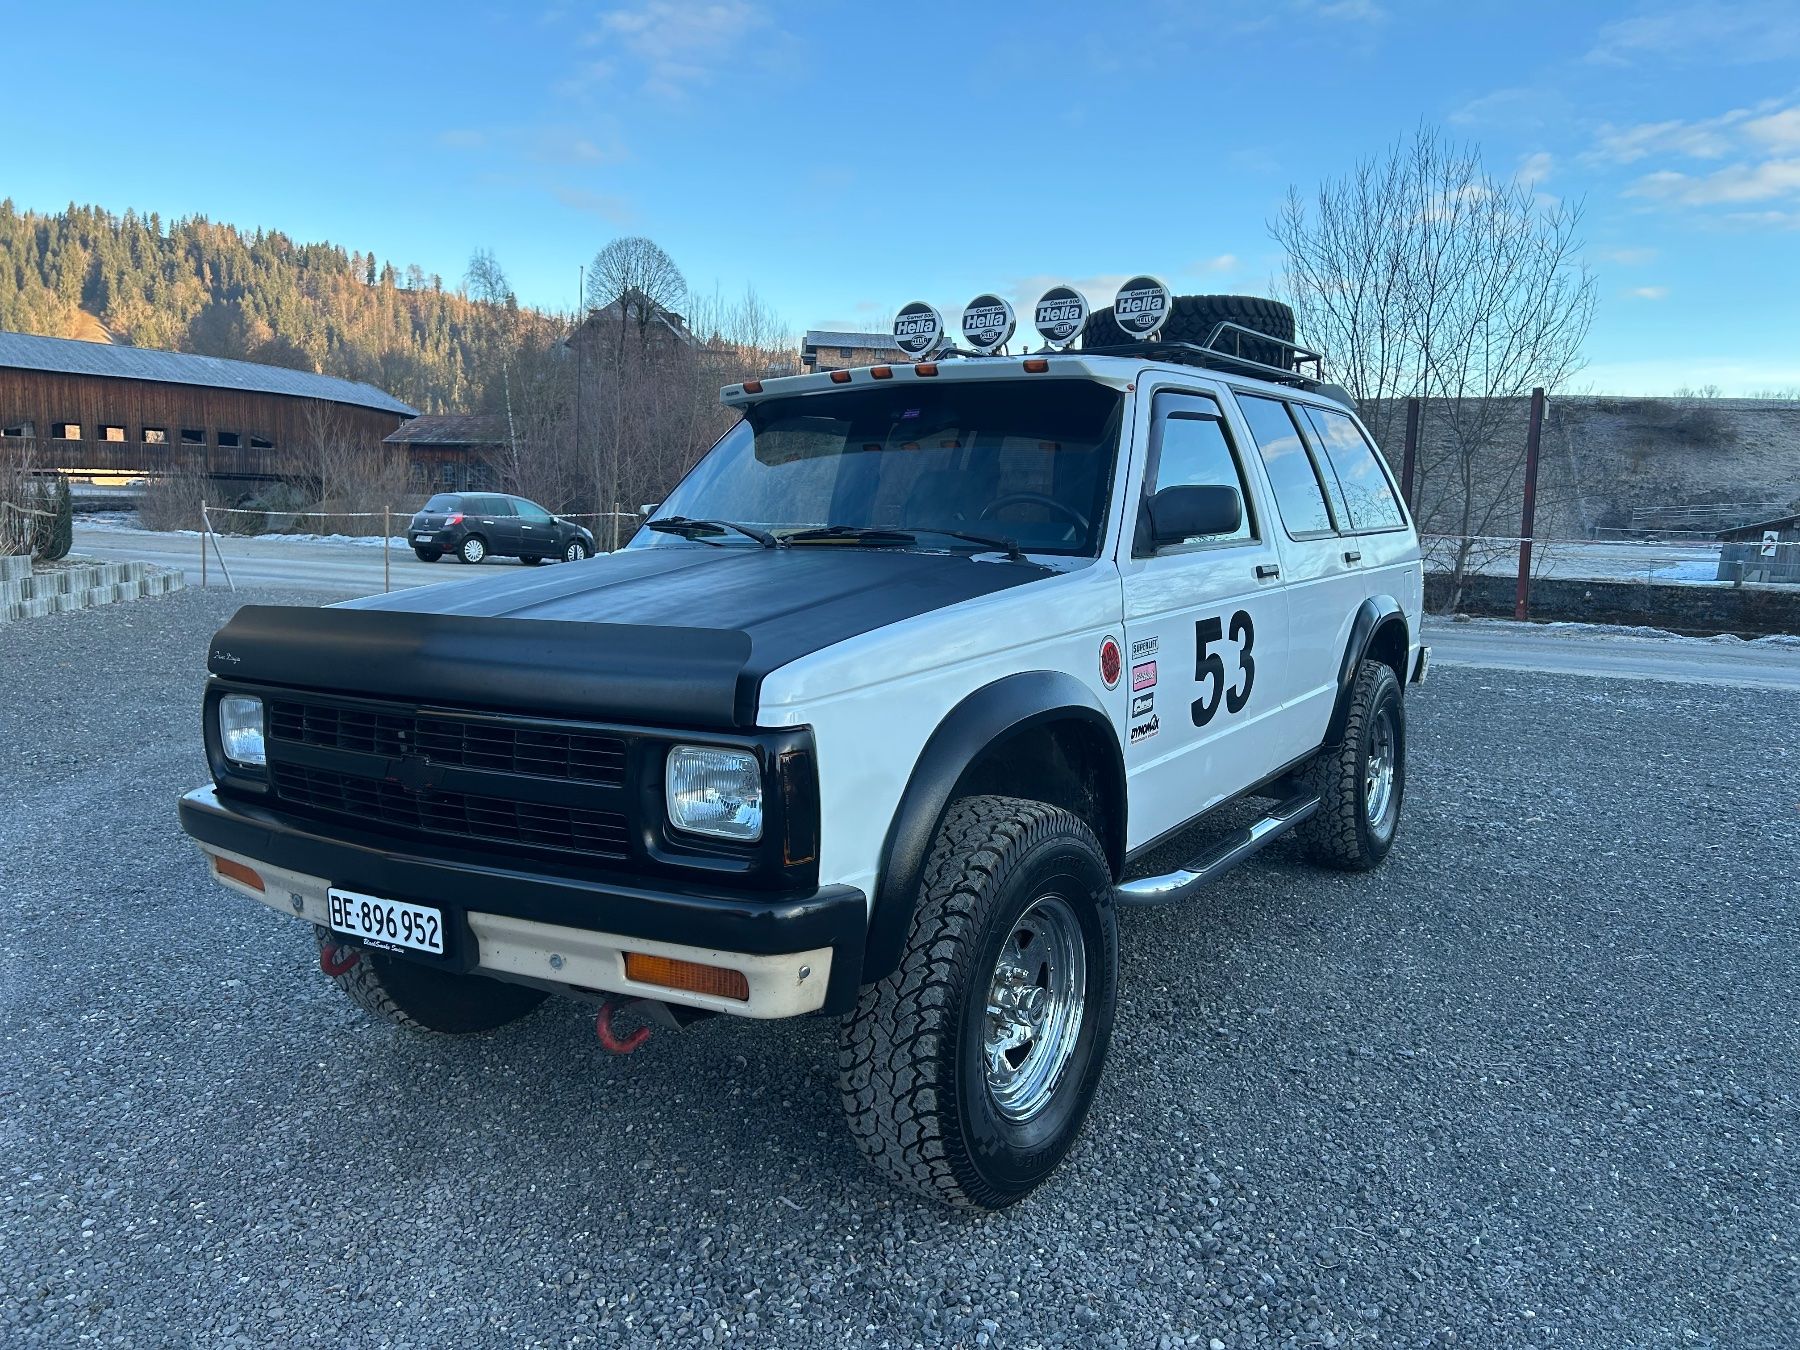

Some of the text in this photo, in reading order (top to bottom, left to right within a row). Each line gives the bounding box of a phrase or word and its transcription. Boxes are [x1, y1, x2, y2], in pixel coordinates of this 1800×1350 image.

[1118, 297, 1163, 313] Hella
[965, 313, 1004, 329] Hella
[1038, 306, 1080, 322] Hella
[896, 320, 934, 335] Hella
[1191, 609, 1255, 728] 53
[1131, 713, 1160, 740] DYNOMAX
